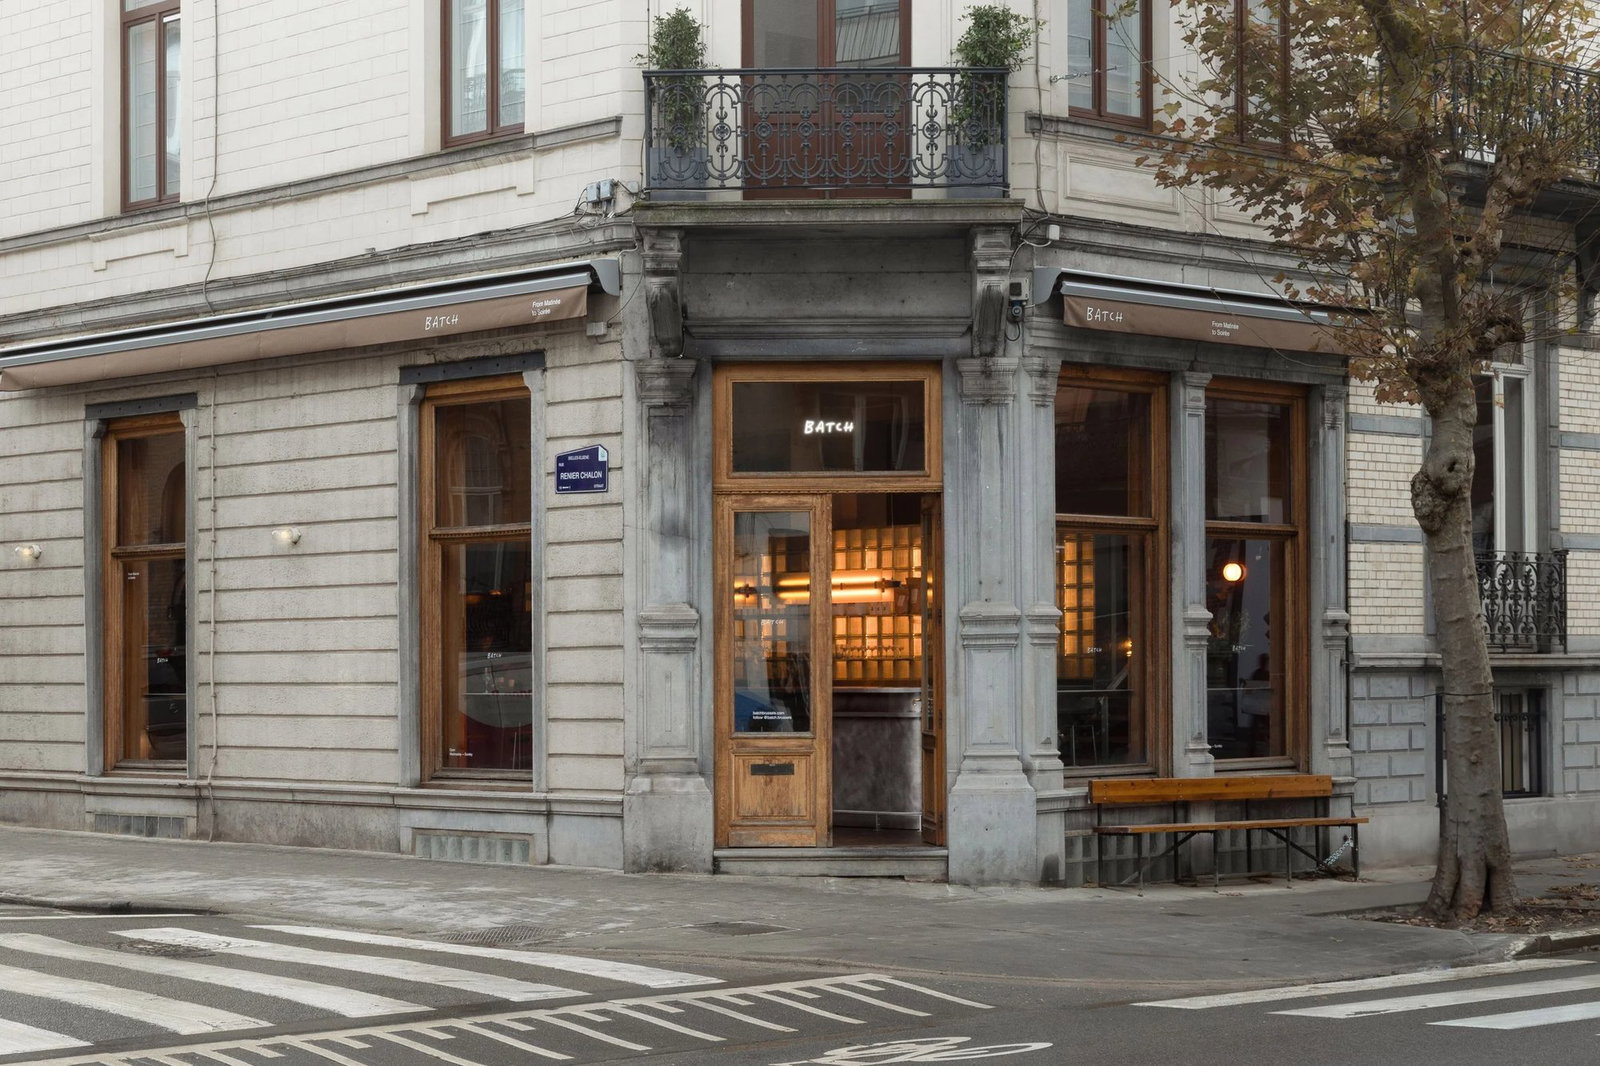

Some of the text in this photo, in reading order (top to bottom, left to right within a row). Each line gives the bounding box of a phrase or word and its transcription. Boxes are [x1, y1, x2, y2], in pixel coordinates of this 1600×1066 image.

[1086, 307, 1123, 323] BATCH
[425, 315, 459, 331] BATCH
[1211, 320, 1223, 328] From
[803, 419, 855, 434] BATCH
[560, 470, 603, 480] RENIER CHALON
